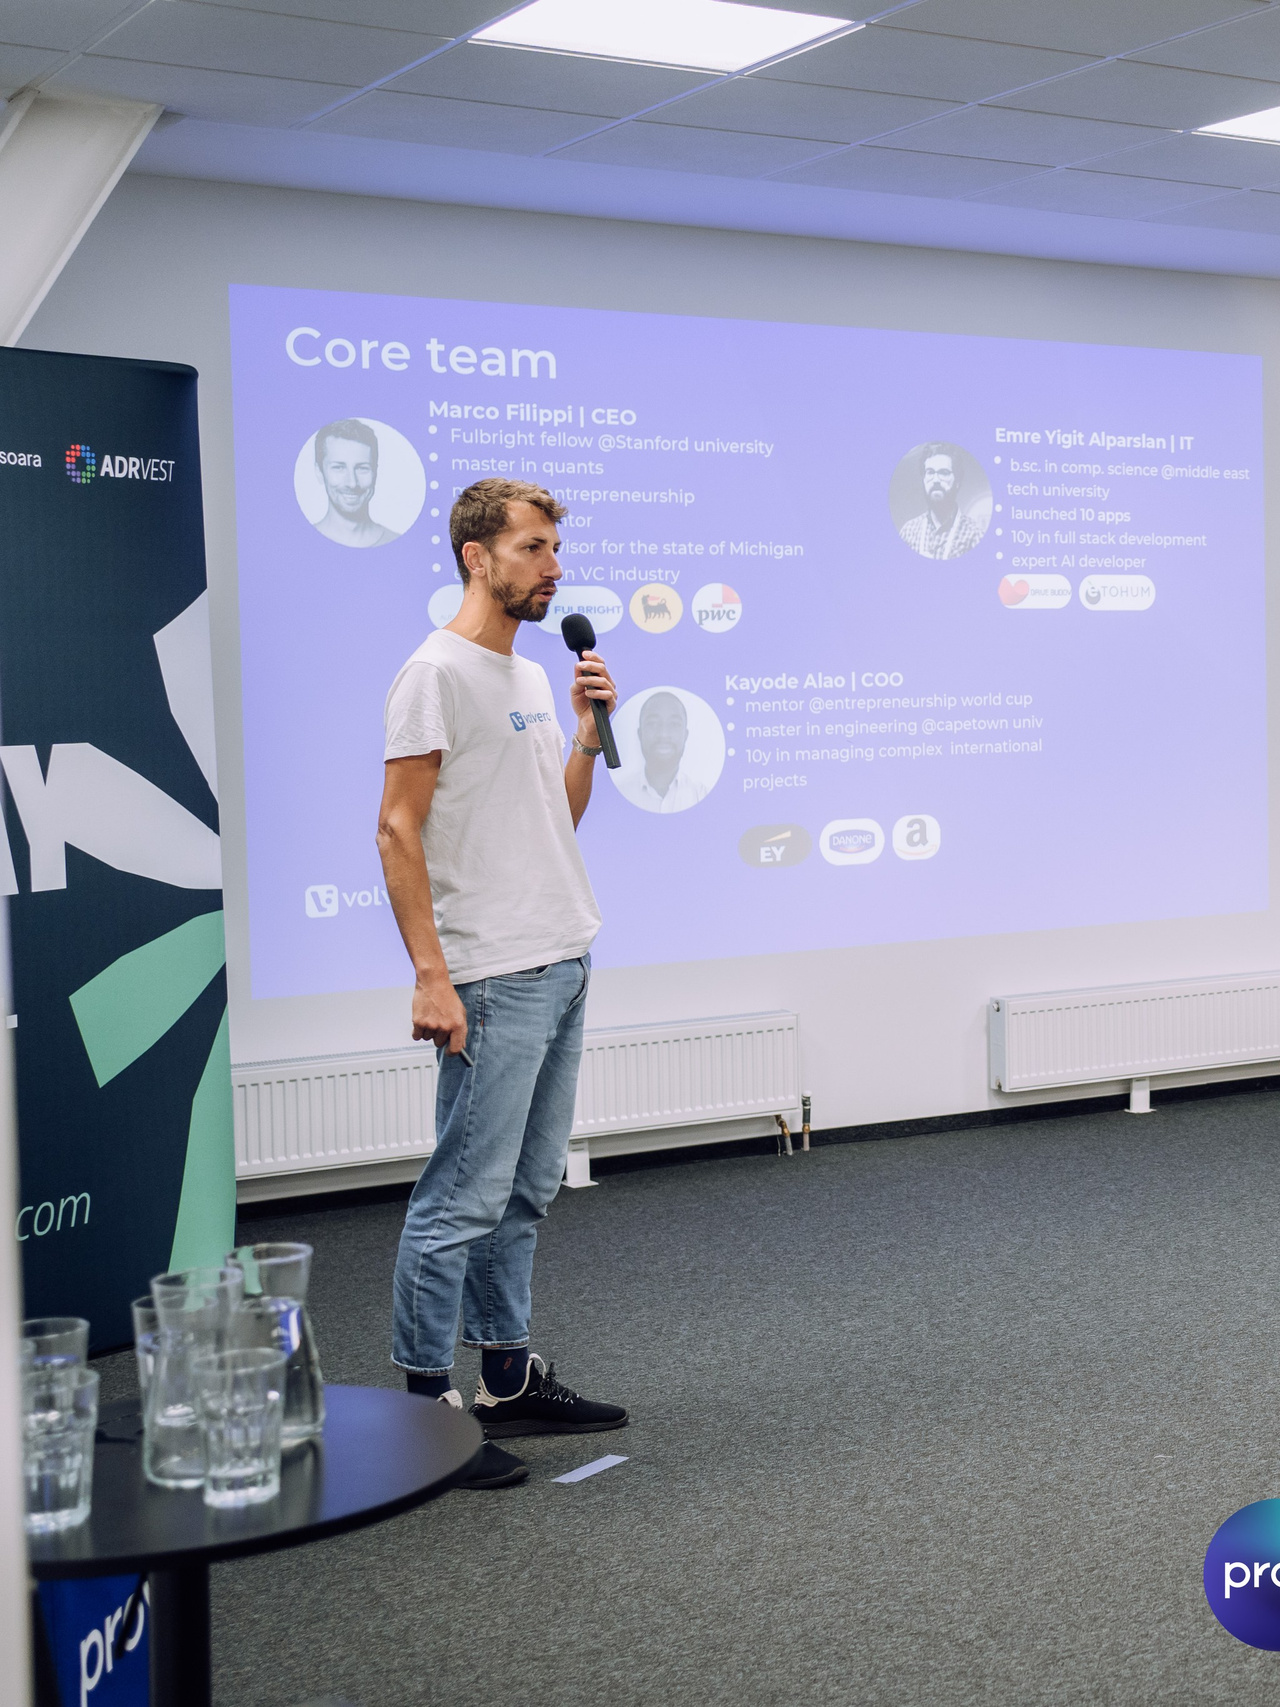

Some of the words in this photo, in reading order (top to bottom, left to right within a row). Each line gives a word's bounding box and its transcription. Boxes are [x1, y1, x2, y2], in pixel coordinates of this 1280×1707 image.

[285, 326, 411, 371] Core
[426, 338, 557, 379] team
[429, 400, 499, 420] Marco
[506, 403, 573, 427] Filippi
[591, 408, 637, 426] CEO
[450, 428, 535, 448] Fulbright
[540, 432, 593, 448] fellow
[598, 434, 689, 452] @Stanford
[694, 438, 774, 458] university
[995, 427, 1041, 444] Emre
[1045, 430, 1084, 448] Yigit
[1089, 432, 1166, 450] Alparslan
[1180, 436, 1194, 450] IT
[100, 454, 176, 482] ADRVEST
[452, 455, 515, 472] master
[521, 457, 537, 472] in
[542, 460, 604, 476] quants
[1010, 459, 1041, 473] b.sc.
[1045, 460, 1058, 473] in
[1061, 463, 1104, 477] comp.
[1107, 462, 1158, 477] science
[1161, 464, 1220, 480] @middle
[1223, 467, 1250, 480] east
[1007, 482, 1038, 496] tech
[1043, 484, 1110, 501] university
[1011, 507, 1077, 520] launched
[1079, 508, 1094, 521] 10
[1097, 510, 1131, 524] apps
[601, 539, 625, 554] for
[630, 540, 658, 555] the
[662, 541, 705, 555] state
[709, 540, 725, 556] of
[729, 541, 804, 559] Michigan
[1011, 530, 1034, 547] 10y
[1038, 530, 1050, 544] in
[1054, 530, 1076, 544] full
[1079, 532, 1116, 545] stack
[1119, 533, 1207, 549] development
[1012, 555, 1057, 570] expert
[1061, 555, 1075, 568] AI
[1079, 555, 1147, 571] developer
[580, 566, 605, 581] VC
[610, 567, 680, 585] industry
[1101, 586, 1151, 598] TOHUM
[554, 605, 622, 615] FULBRIGHT
[697, 609, 736, 625] pwc
[725, 674, 799, 694] Kayode
[803, 672, 846, 689] Alao
[861, 672, 904, 688] COO
[745, 697, 804, 713] mentor
[809, 694, 957, 714] @entrepreneurship
[960, 692, 1001, 707] world
[1005, 694, 1033, 709] cup
[746, 723, 801, 738] master
[807, 721, 821, 736] in
[824, 718, 918, 738] engineering
[921, 716, 1008, 735] @capetown
[1013, 715, 1043, 729] univ
[746, 748, 772, 767] 10y
[776, 747, 790, 762] in
[795, 745, 875, 765] managing
[878, 741, 943, 761] complex
[950, 738, 1043, 755] international
[743, 773, 808, 792] projects
[760, 845, 785, 863] EY
[80, 1580, 150, 1707] pro
